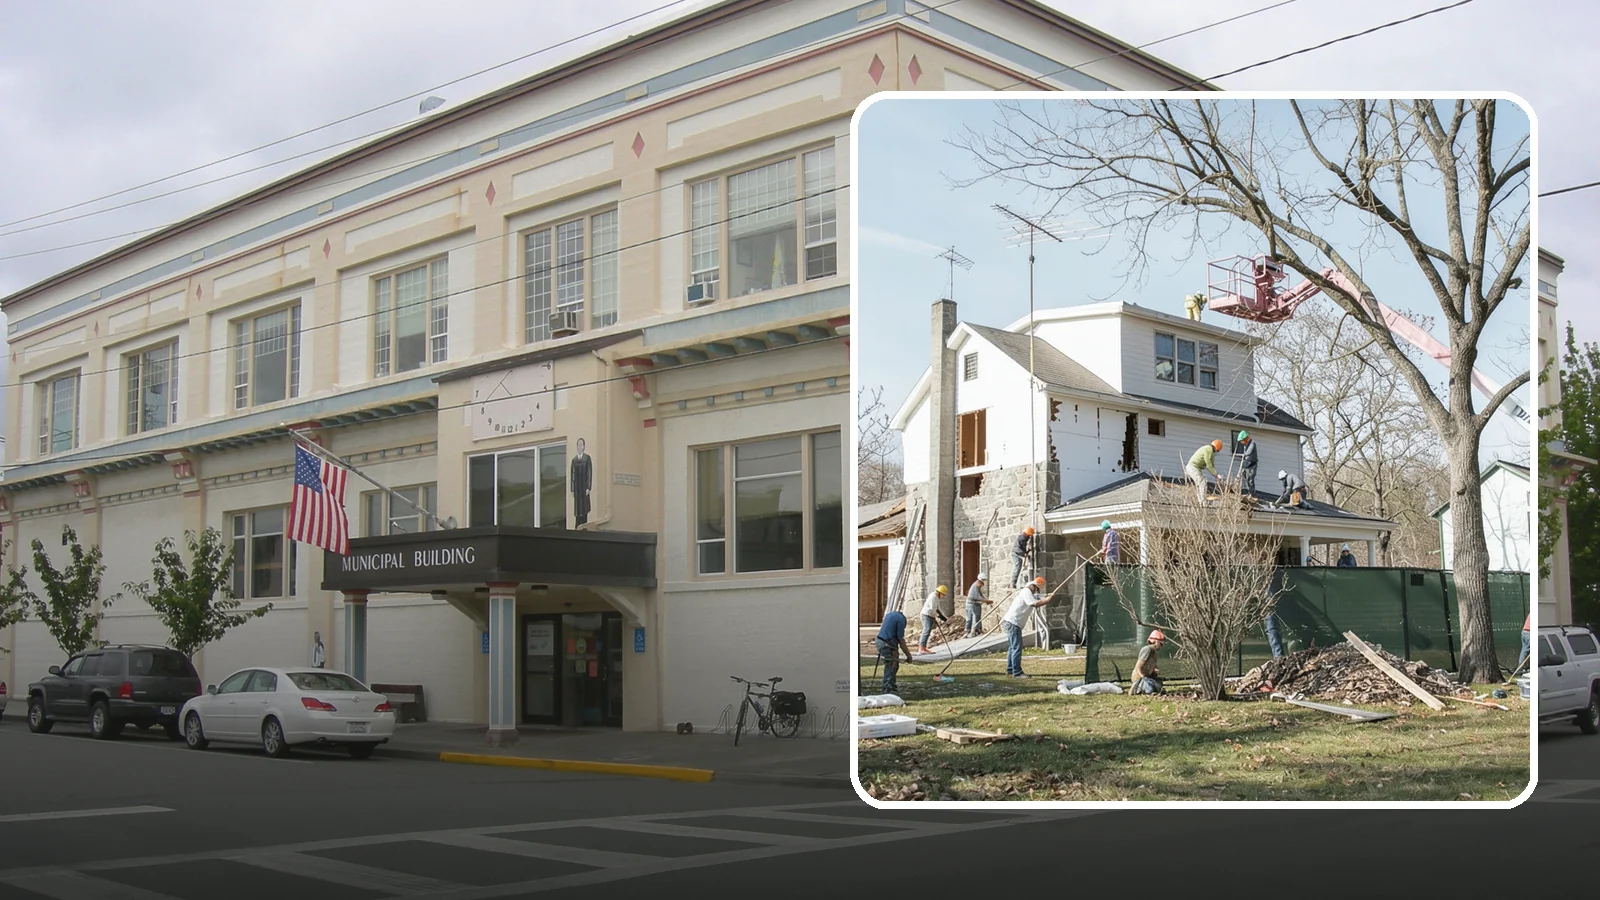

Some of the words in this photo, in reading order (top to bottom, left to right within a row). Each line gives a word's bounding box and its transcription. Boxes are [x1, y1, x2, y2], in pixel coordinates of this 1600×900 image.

[487, 417, 492, 426] 9
[528, 413, 533, 422] 3
[521, 420, 526, 428] 2
[342, 552, 405, 572] MUNICIPAL
[414, 546, 475, 567] BUILDING
